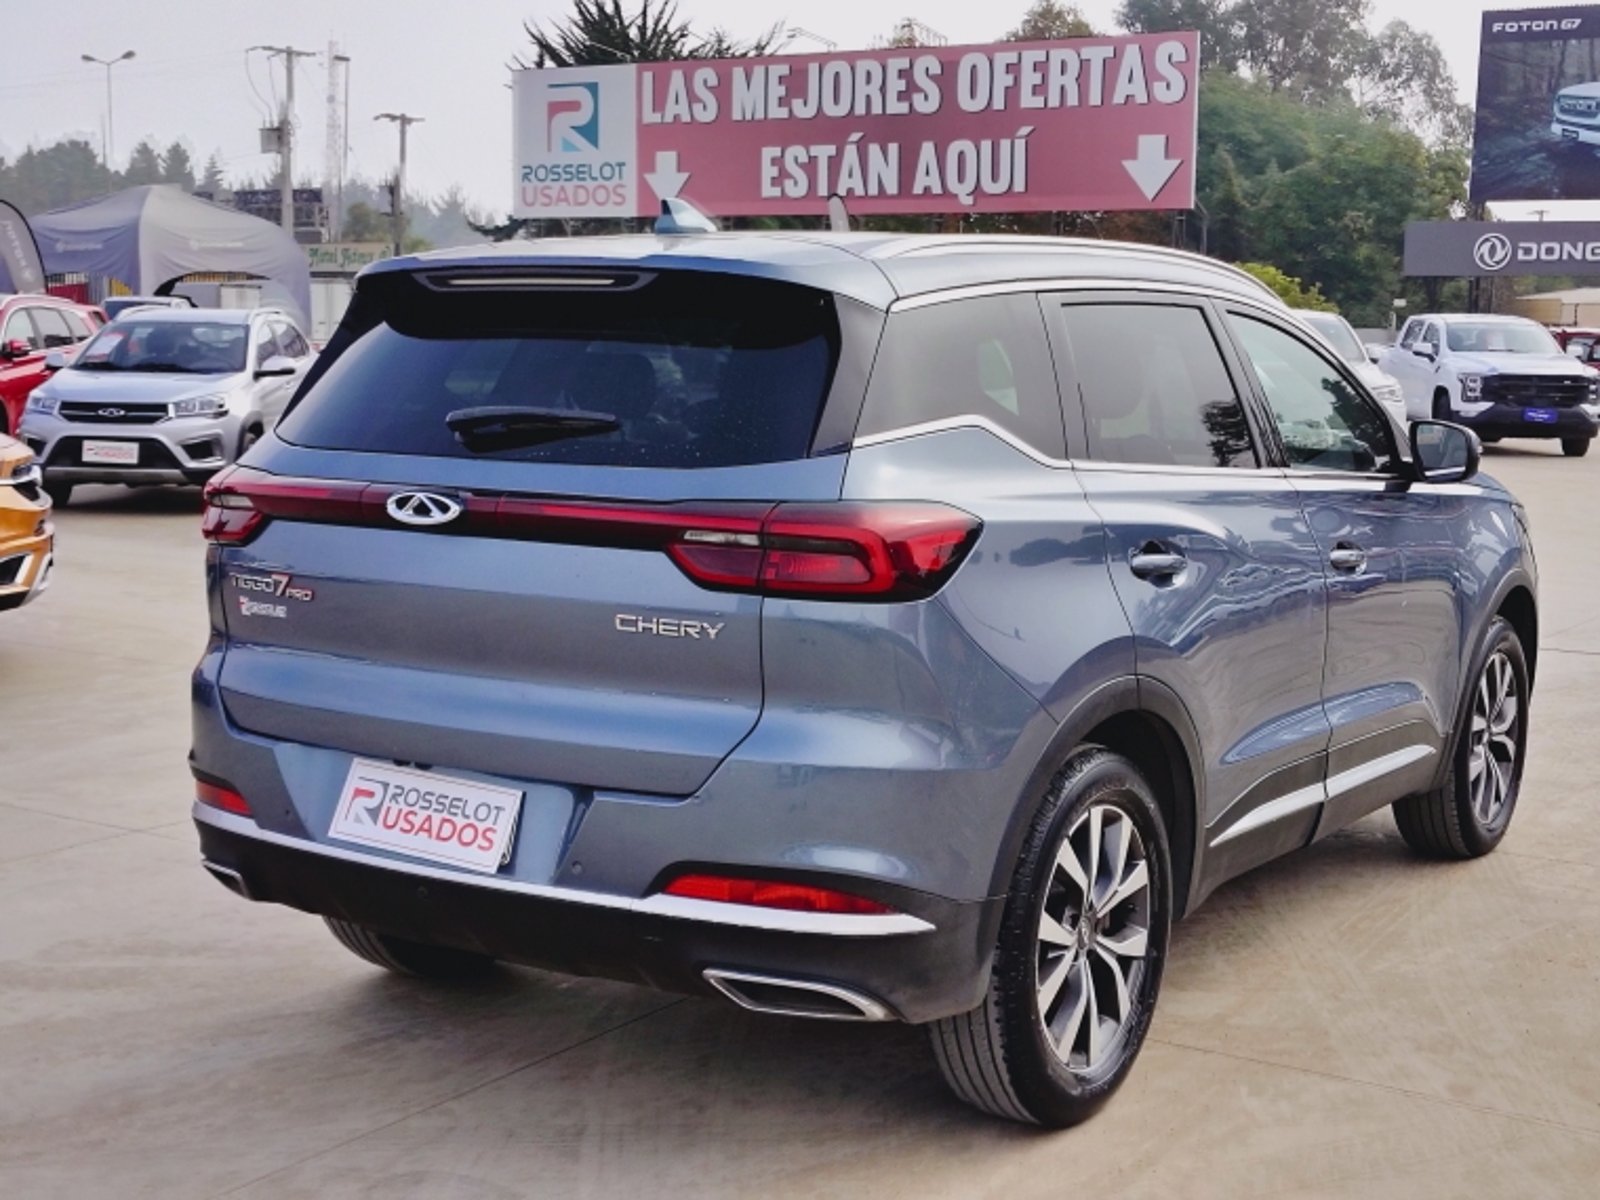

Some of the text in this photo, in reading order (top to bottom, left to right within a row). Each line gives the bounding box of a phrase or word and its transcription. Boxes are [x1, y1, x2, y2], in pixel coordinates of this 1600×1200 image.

[1491, 18, 1582, 33] FOTON G7
[641, 40, 1188, 125] LAS MEJORES OFERTAS
[521, 161, 626, 183] ROSSELOT
[761, 125, 1036, 205] ESTÁN AQUÍ
[521, 184, 627, 207] USADOS
[614, 613, 725, 640] CHERY
[388, 784, 506, 827] ROSSELOT
[382, 806, 497, 852] USADOS
